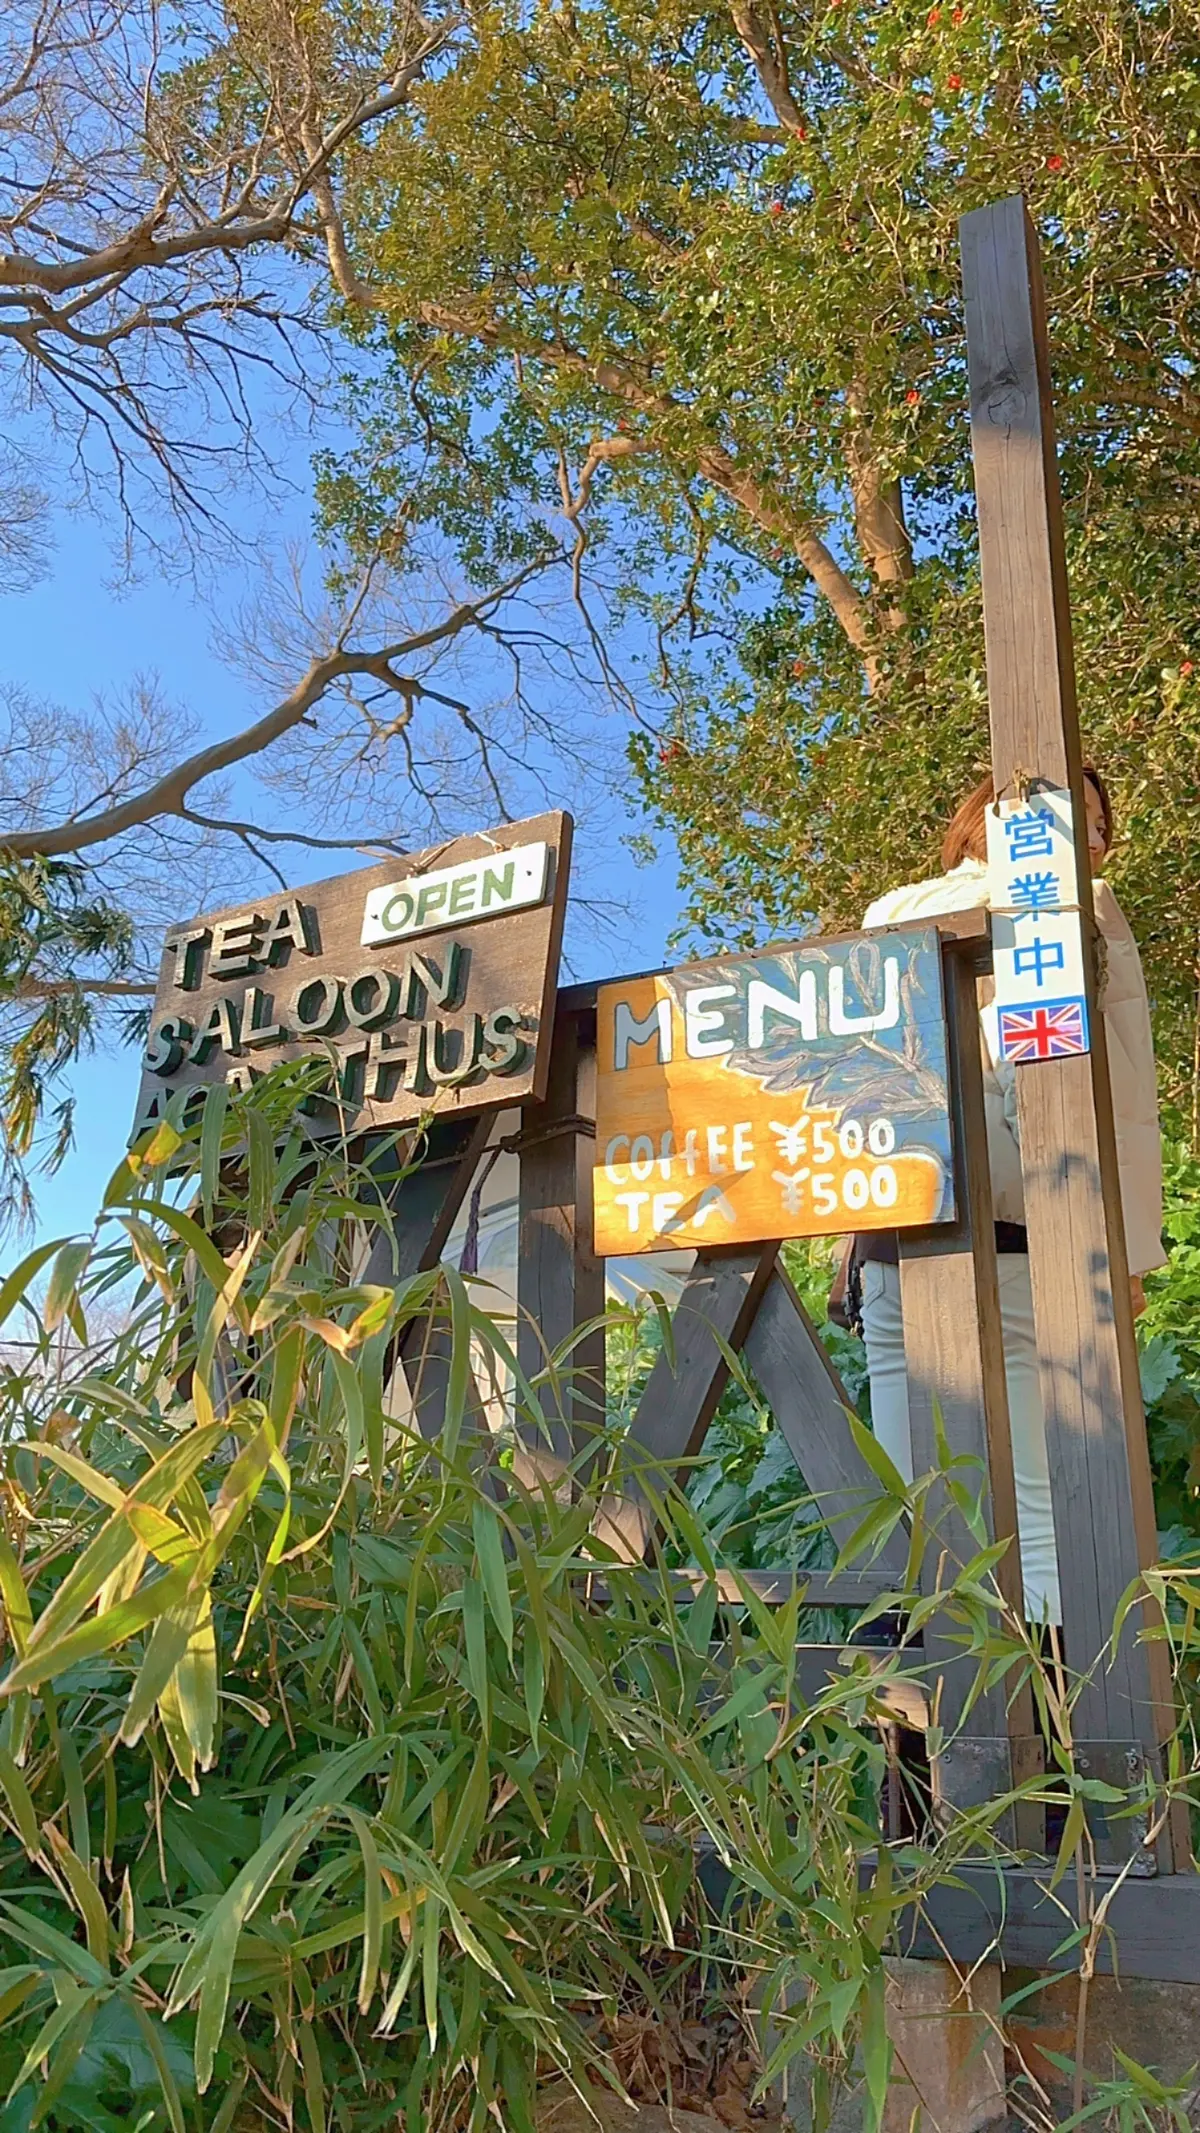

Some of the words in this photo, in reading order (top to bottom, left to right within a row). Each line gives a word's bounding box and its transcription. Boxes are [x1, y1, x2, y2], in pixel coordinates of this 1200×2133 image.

[381, 862, 514, 932] OPEN
[1004, 808, 1065, 986] 営業中
[167, 899, 319, 990] TEA
[142, 942, 466, 1077] SALOON
[613, 956, 900, 1071] MENU
[769, 1115, 896, 1166] ¥500
[614, 1185, 737, 1233] TEA
[771, 1164, 899, 1215] ¥500
